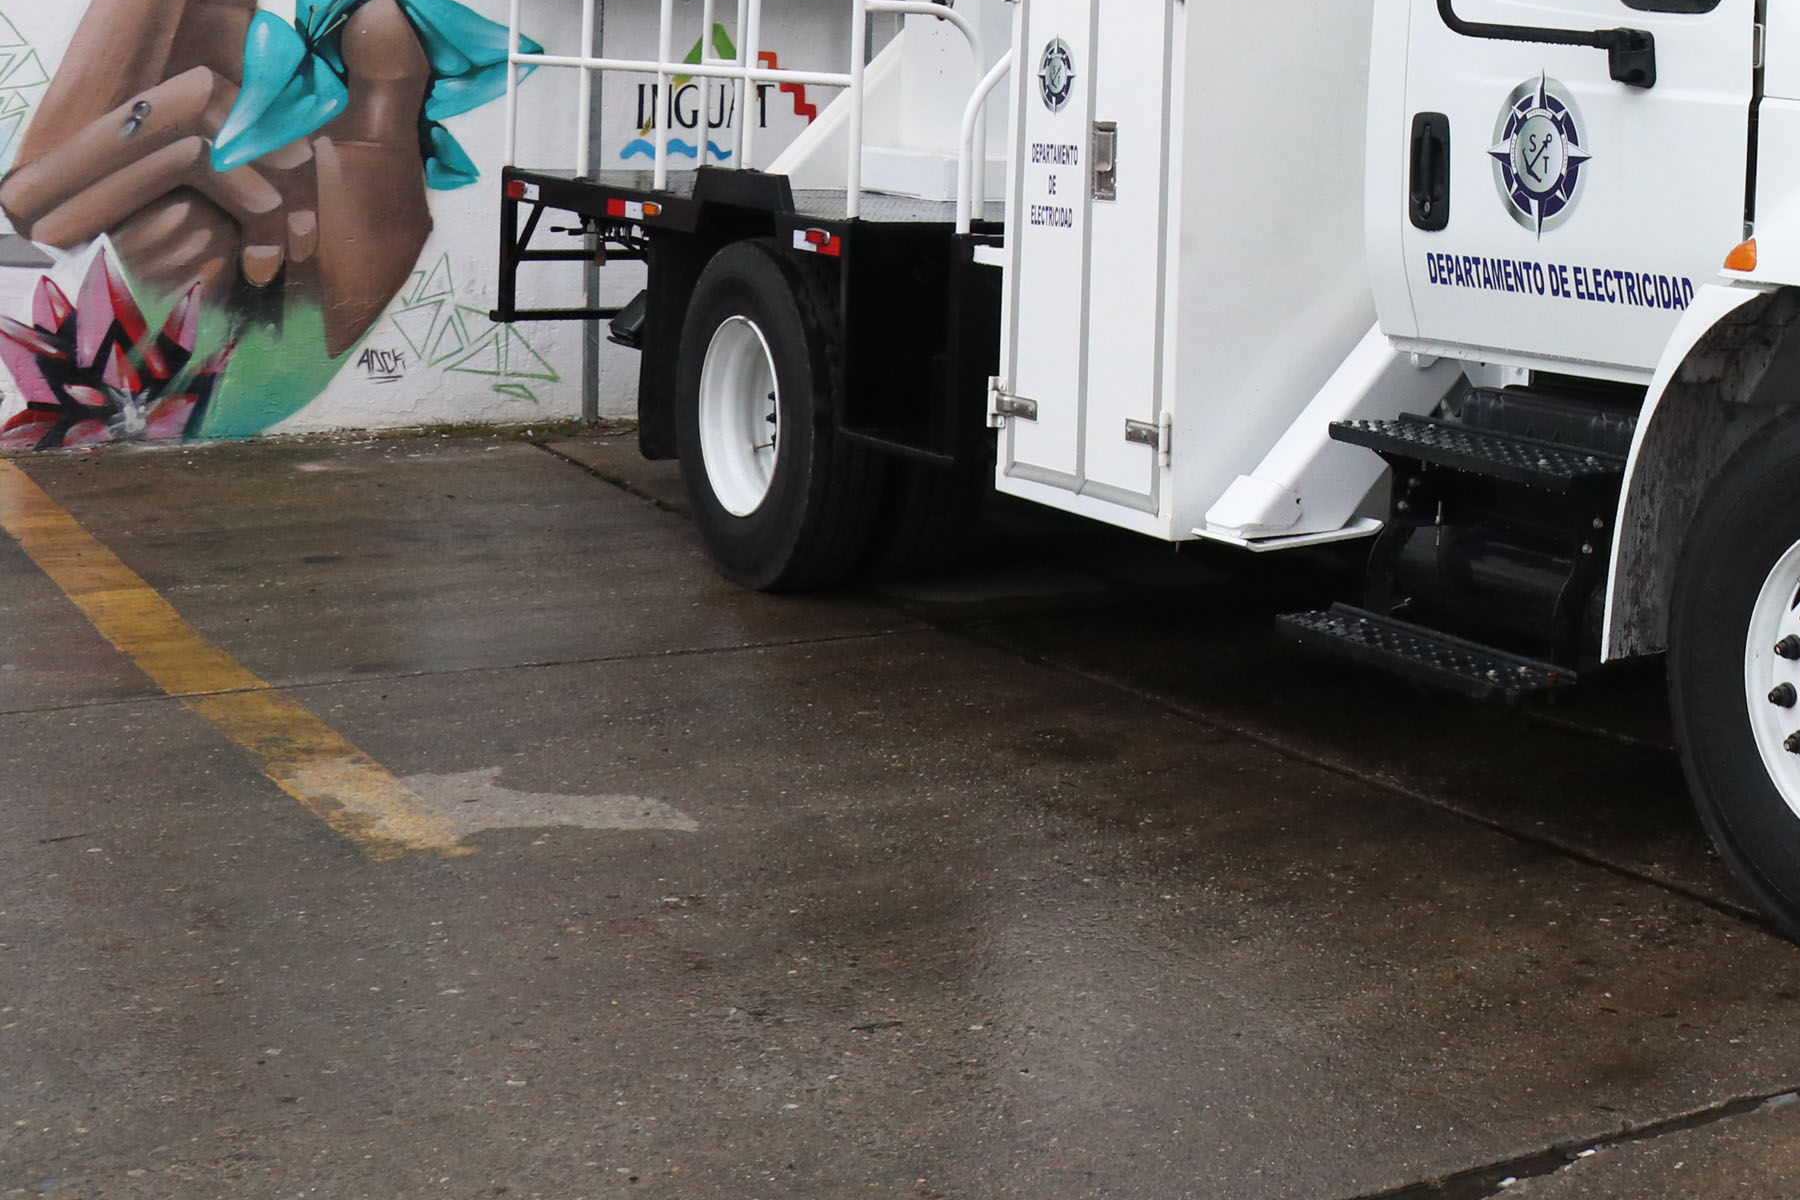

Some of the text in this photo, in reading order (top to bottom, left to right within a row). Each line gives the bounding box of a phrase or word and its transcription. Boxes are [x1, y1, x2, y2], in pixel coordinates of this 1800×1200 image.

[1032, 142, 1078, 166] DEPARTAMENTO
[1048, 174, 1056, 195] DE
[1031, 204, 1073, 229] ELECTRICIDAD
[1426, 252, 1695, 312] DEPARTAMENTO DE ELECTRICIDAD
